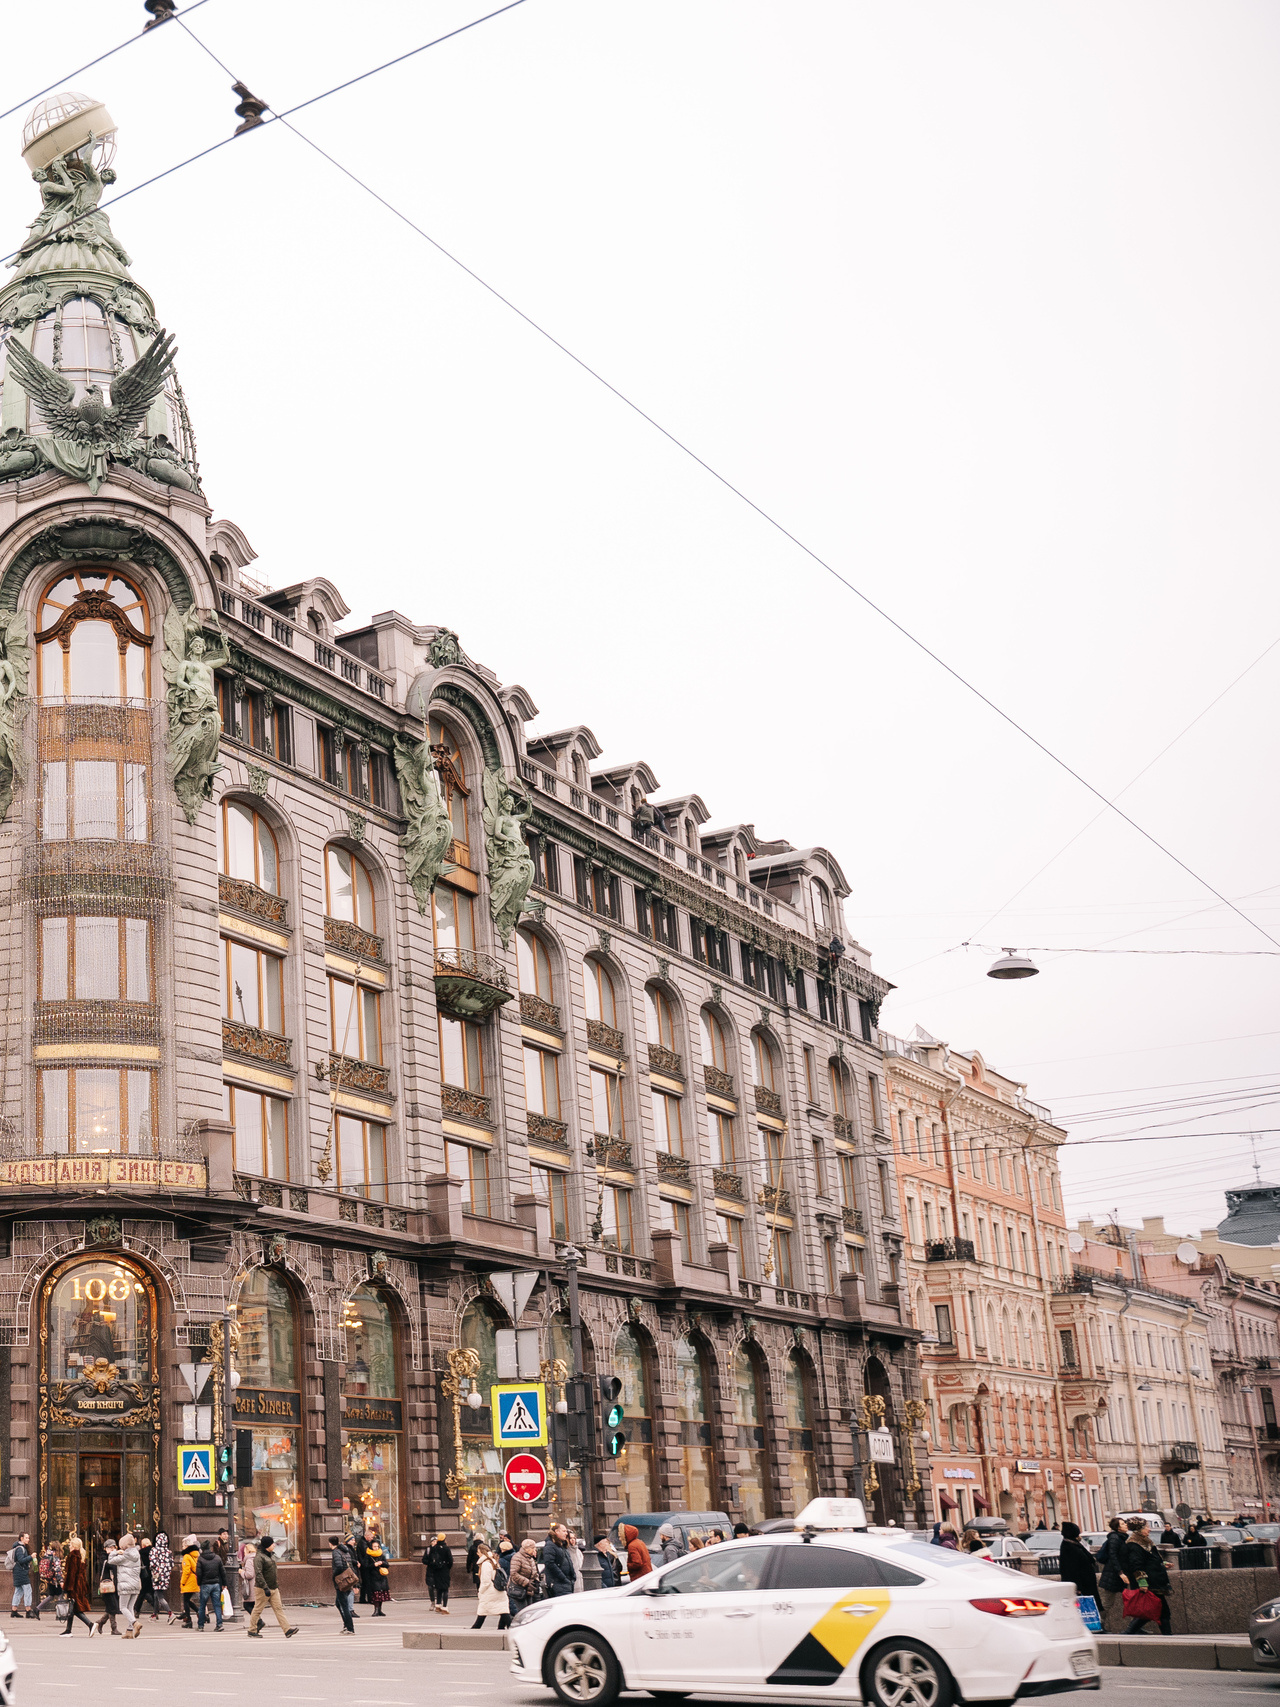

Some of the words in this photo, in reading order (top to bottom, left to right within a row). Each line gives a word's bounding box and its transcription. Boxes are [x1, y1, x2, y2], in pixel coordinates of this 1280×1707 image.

[70, 1277, 131, 1301] 100
[235, 1397, 255, 1414] CAFE
[258, 1392, 294, 1417] SINGER
[873, 1437, 891, 1457] СТОП
